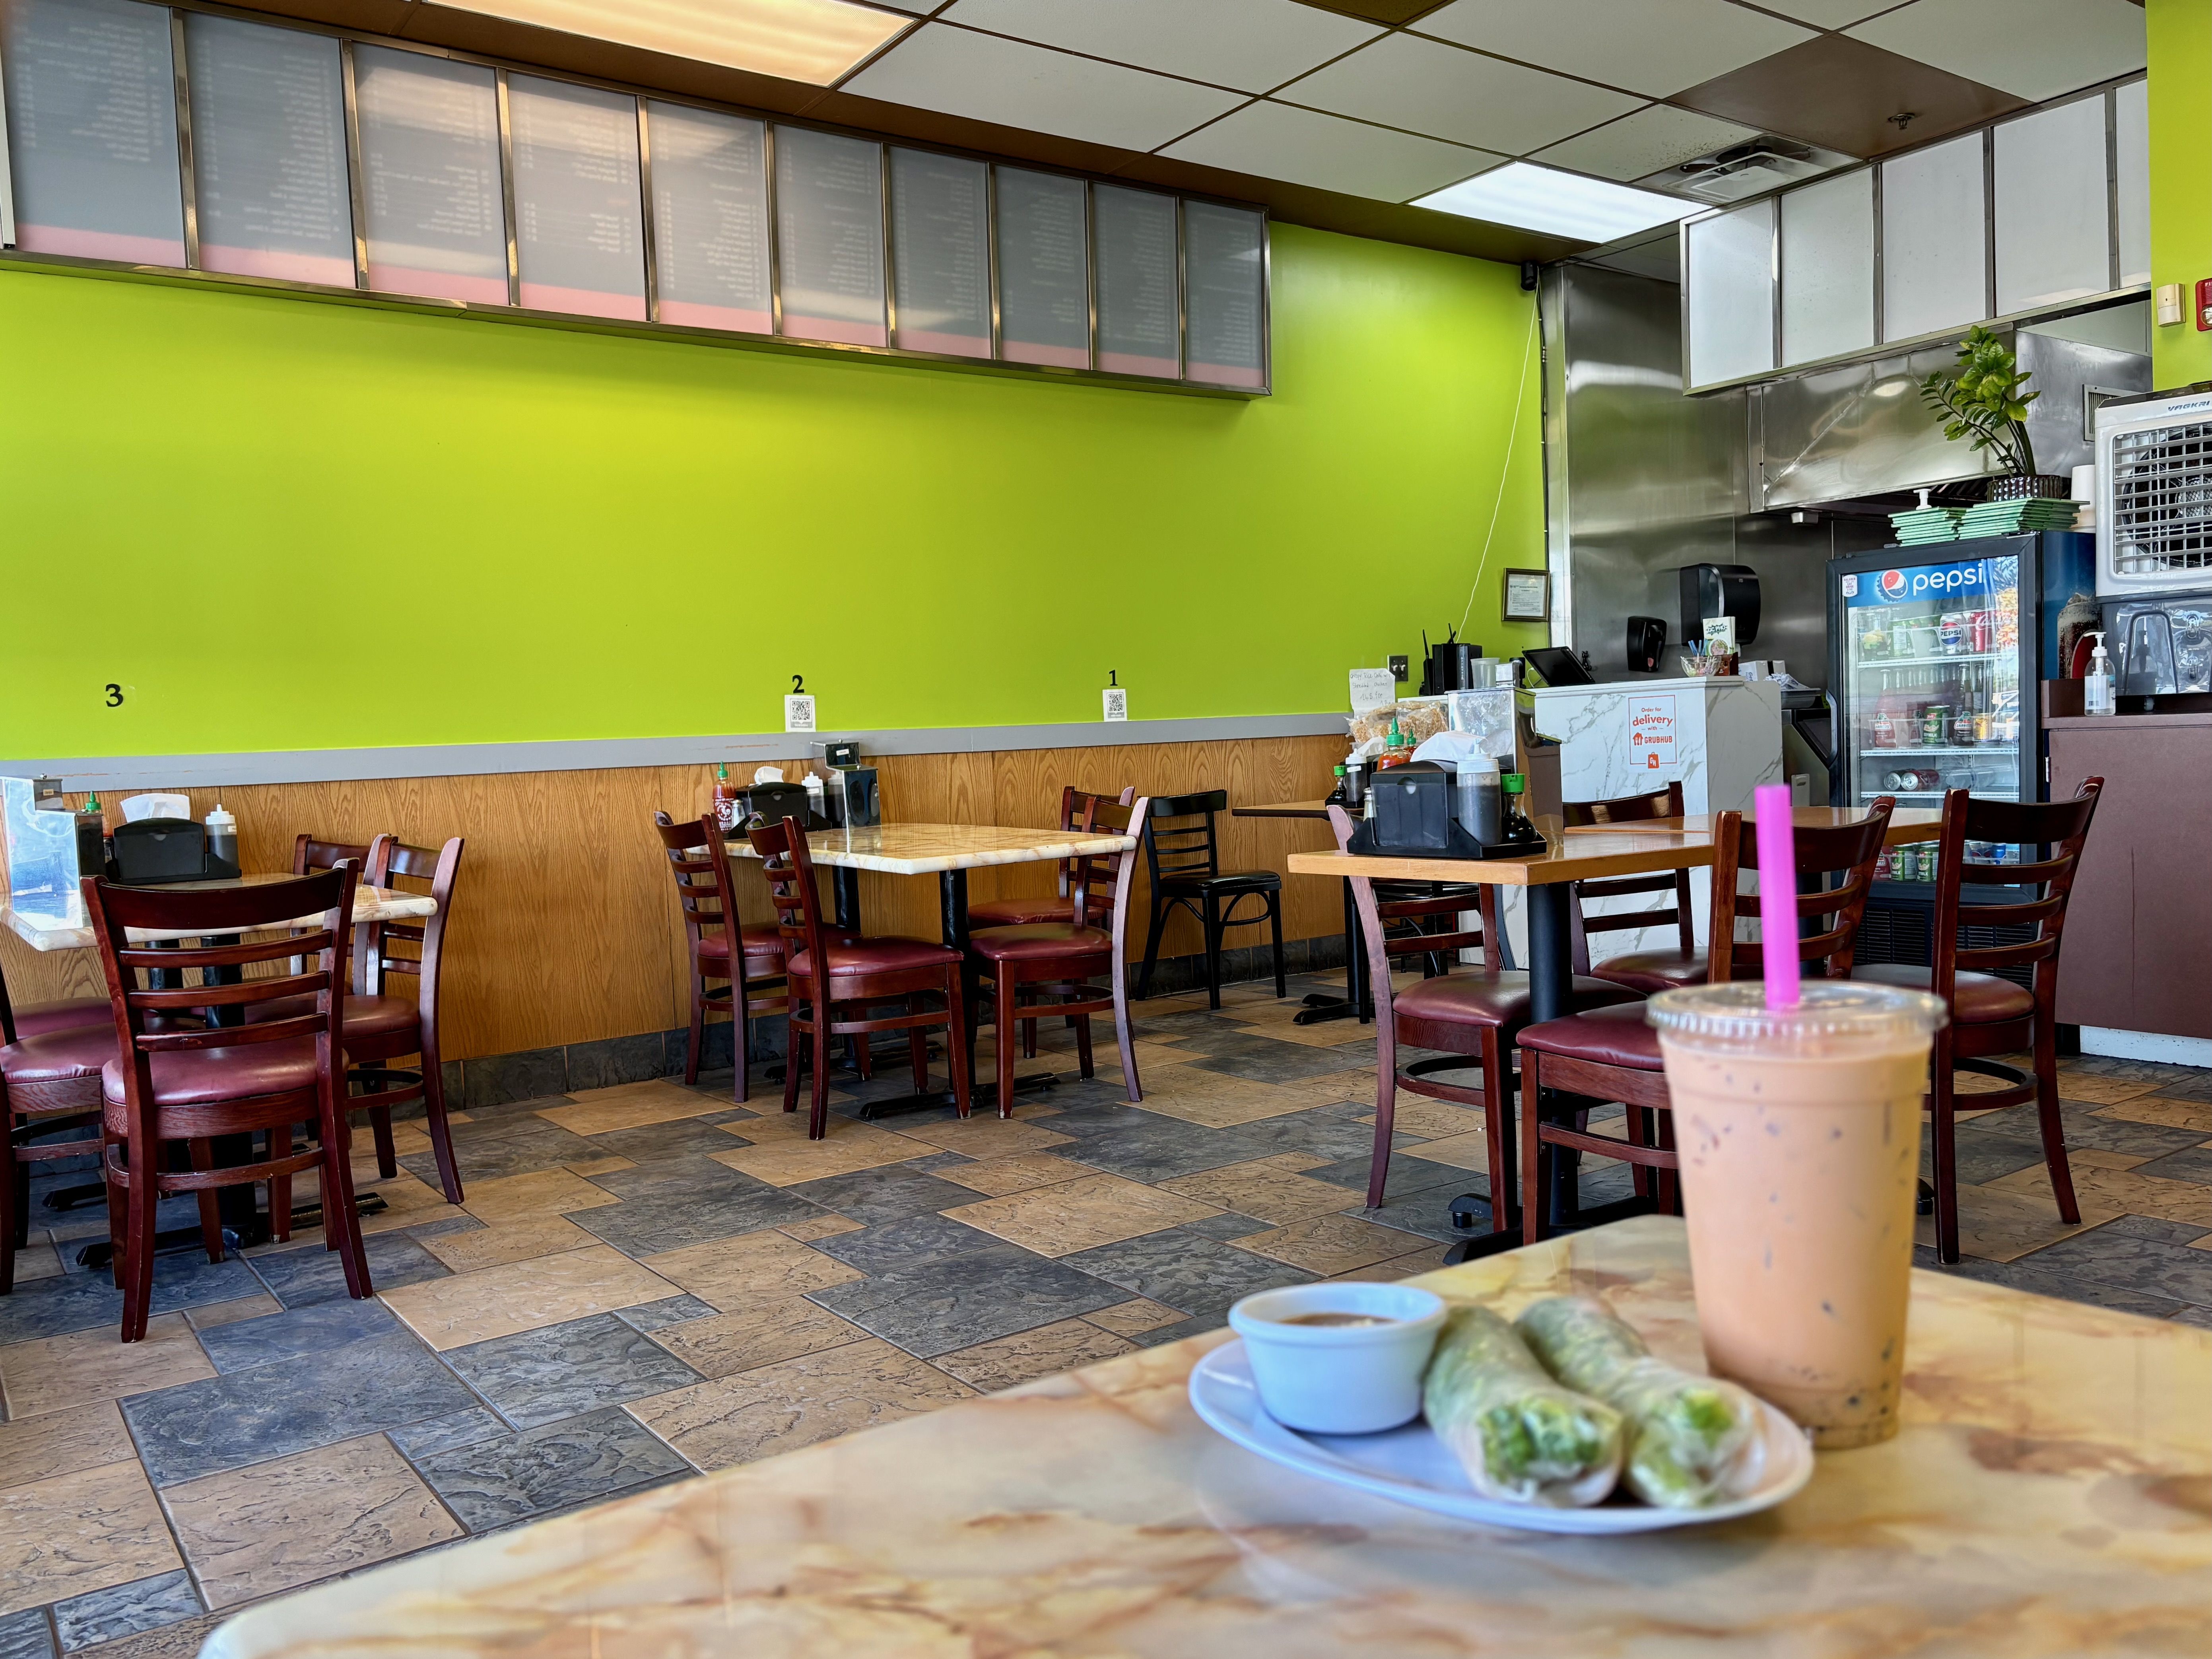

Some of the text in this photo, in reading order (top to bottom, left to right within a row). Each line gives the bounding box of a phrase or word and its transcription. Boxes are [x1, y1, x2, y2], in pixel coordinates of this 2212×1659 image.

[2168, 400, 2210, 411] VAGKRI
[1913, 563, 1983, 596] pepsi
[792, 675, 804, 694] 2
[1109, 670, 1118, 686] 1
[105, 684, 124, 707] 3
[1633, 714, 1673, 727] delivery
